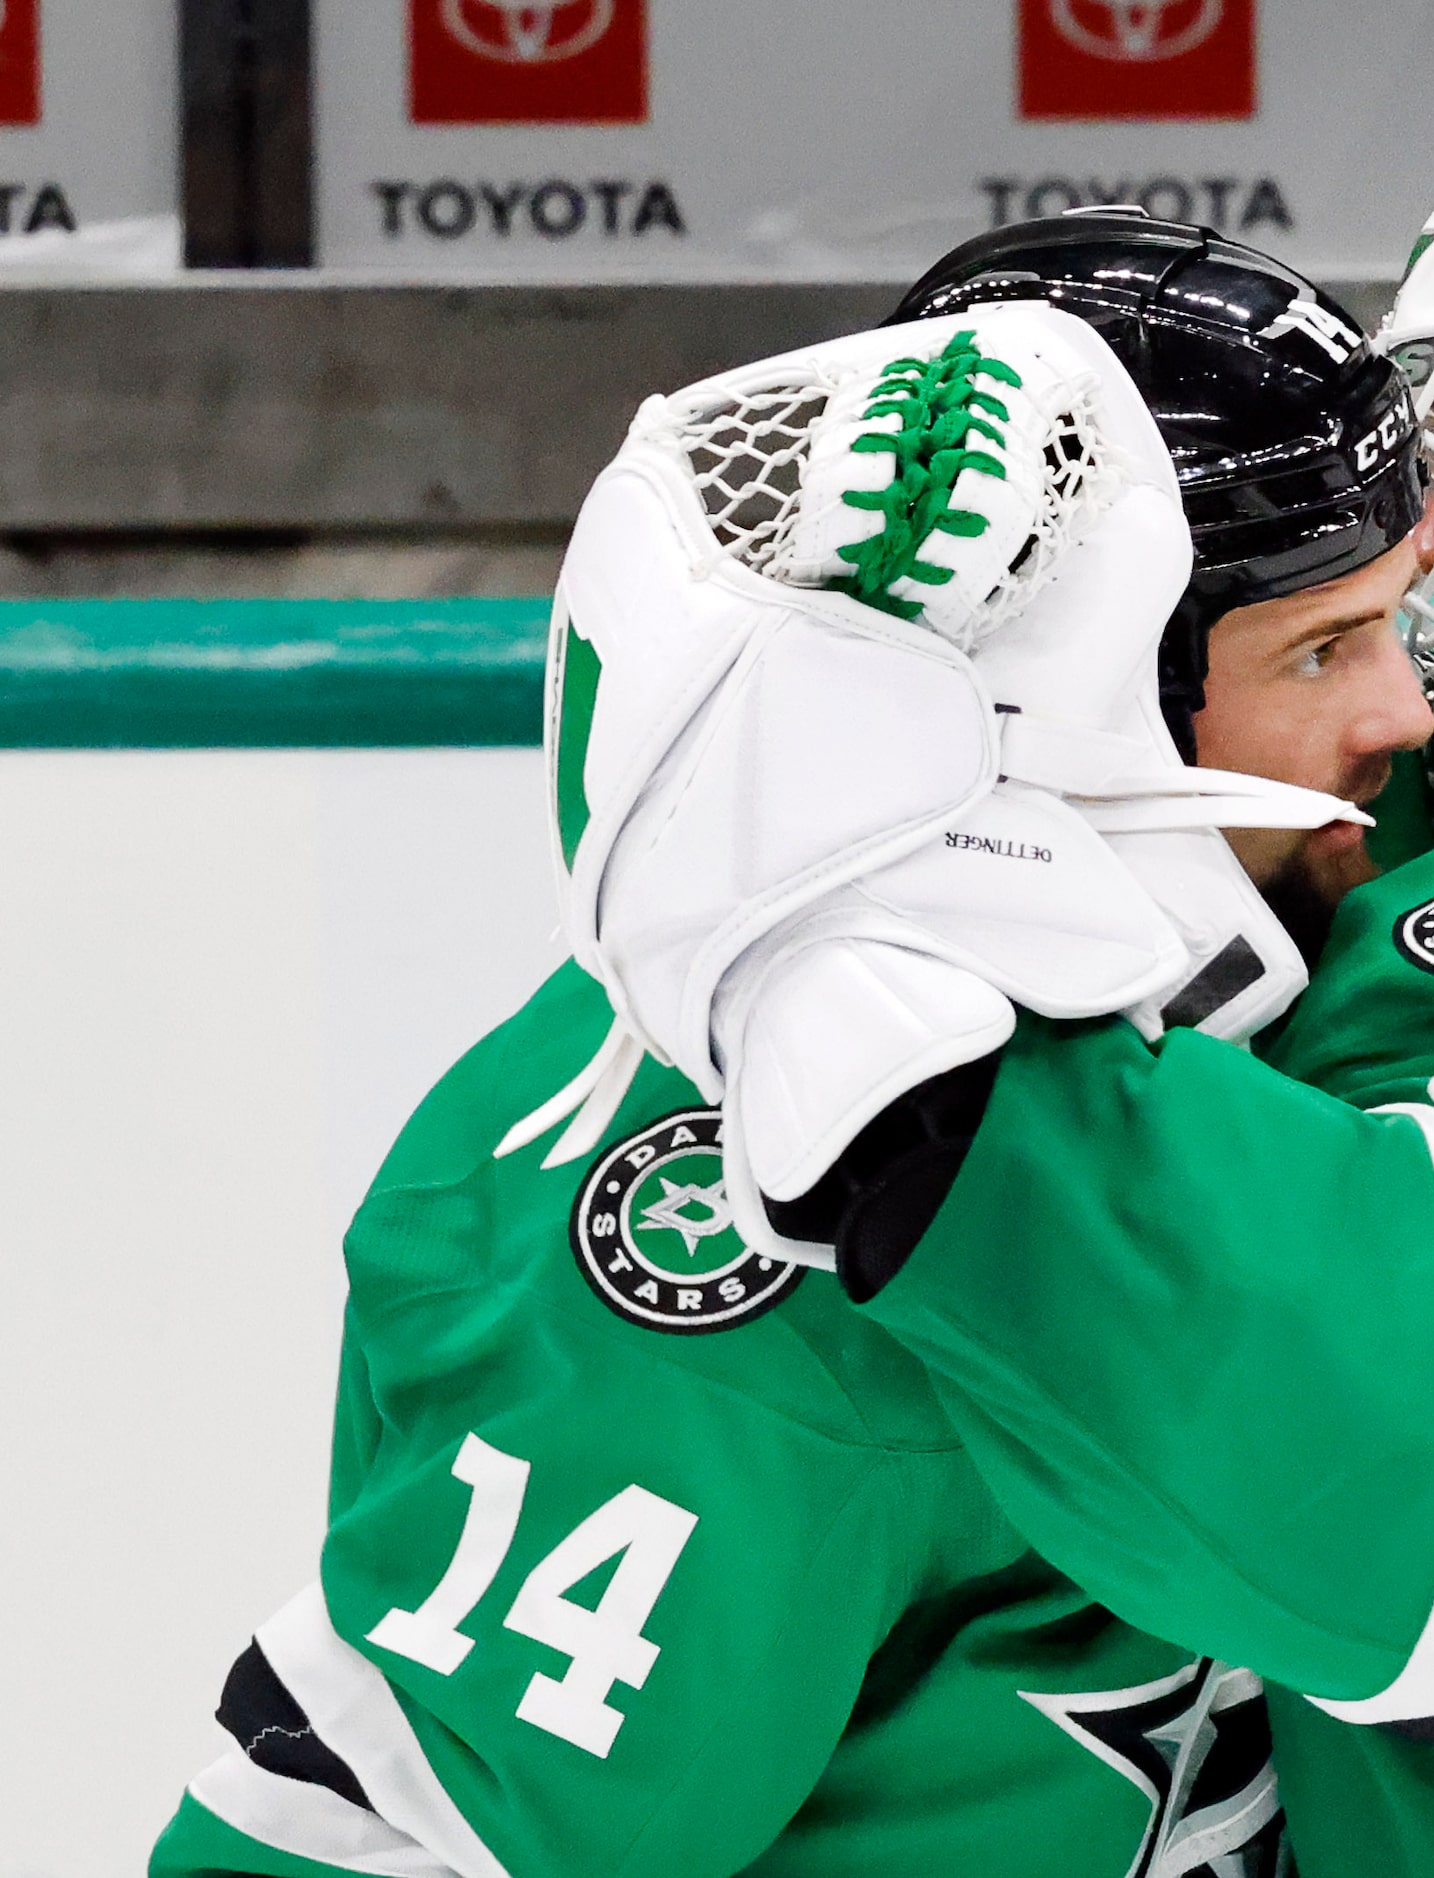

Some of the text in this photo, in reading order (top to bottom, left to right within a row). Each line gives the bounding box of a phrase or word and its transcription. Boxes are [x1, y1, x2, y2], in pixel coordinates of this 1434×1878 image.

[372, 178, 686, 238] TOYOTA
[945, 831, 1053, 863] OETTINGER
[592, 1212, 746, 1311] STARS
[362, 1430, 700, 1760] 14
